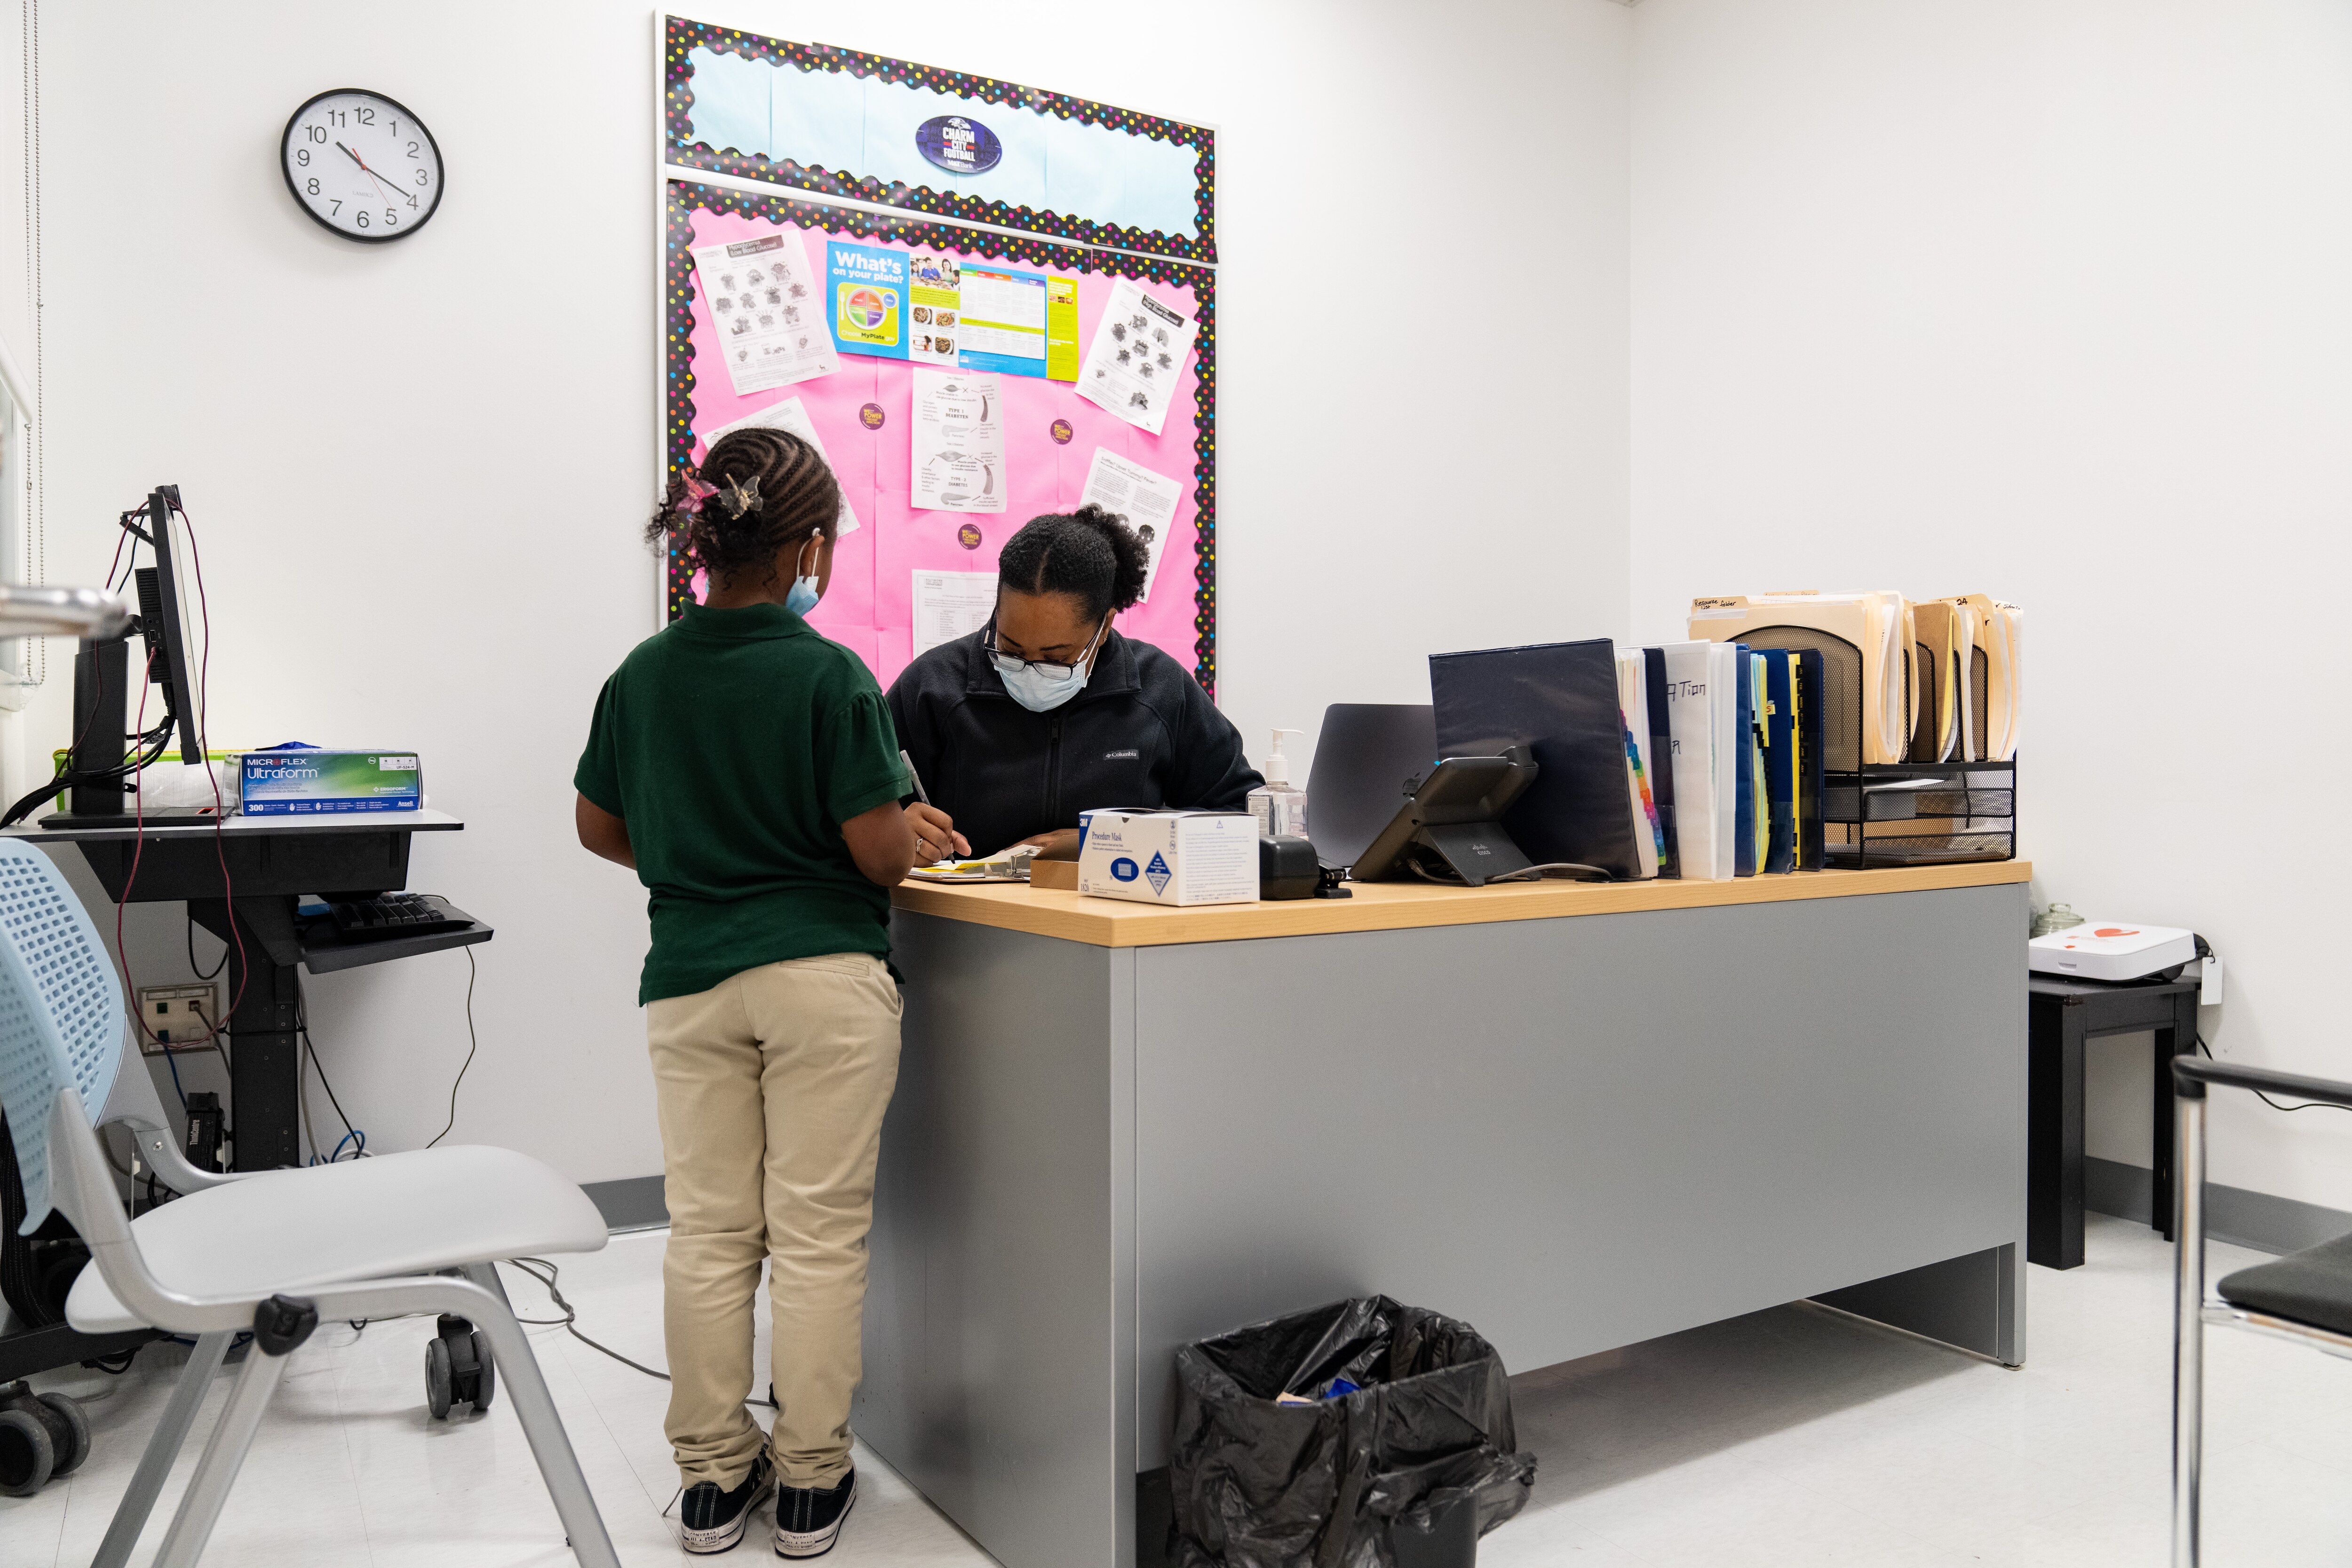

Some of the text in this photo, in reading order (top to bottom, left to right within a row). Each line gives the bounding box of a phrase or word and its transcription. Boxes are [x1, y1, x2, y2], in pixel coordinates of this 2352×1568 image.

[328, 109, 345, 128] 11
[354, 107, 374, 126] 12
[305, 124, 327, 143] 10
[389, 120, 397, 137] 1
[942, 127, 975, 143] CHARM
[407, 142, 419, 158] 2
[952, 140, 967, 151] CITY
[297, 149, 310, 166] 9
[943, 147, 976, 162] FOOTBALL
[415, 169, 428, 186] 3
[307, 178, 320, 195] 8
[329, 199, 342, 216] 7
[406, 194, 419, 210] 4
[357, 211, 369, 228] 6
[385, 208, 397, 225] 5
[835, 251, 902, 275] What's
[832, 267, 904, 284] on your plate?
[1080, 818, 1088, 827] 3M
[1092, 831, 1122, 841] Procedure Mask
[1081, 883, 1089, 892] 1820
[190, 1119, 200, 1145] ThinkCentre
